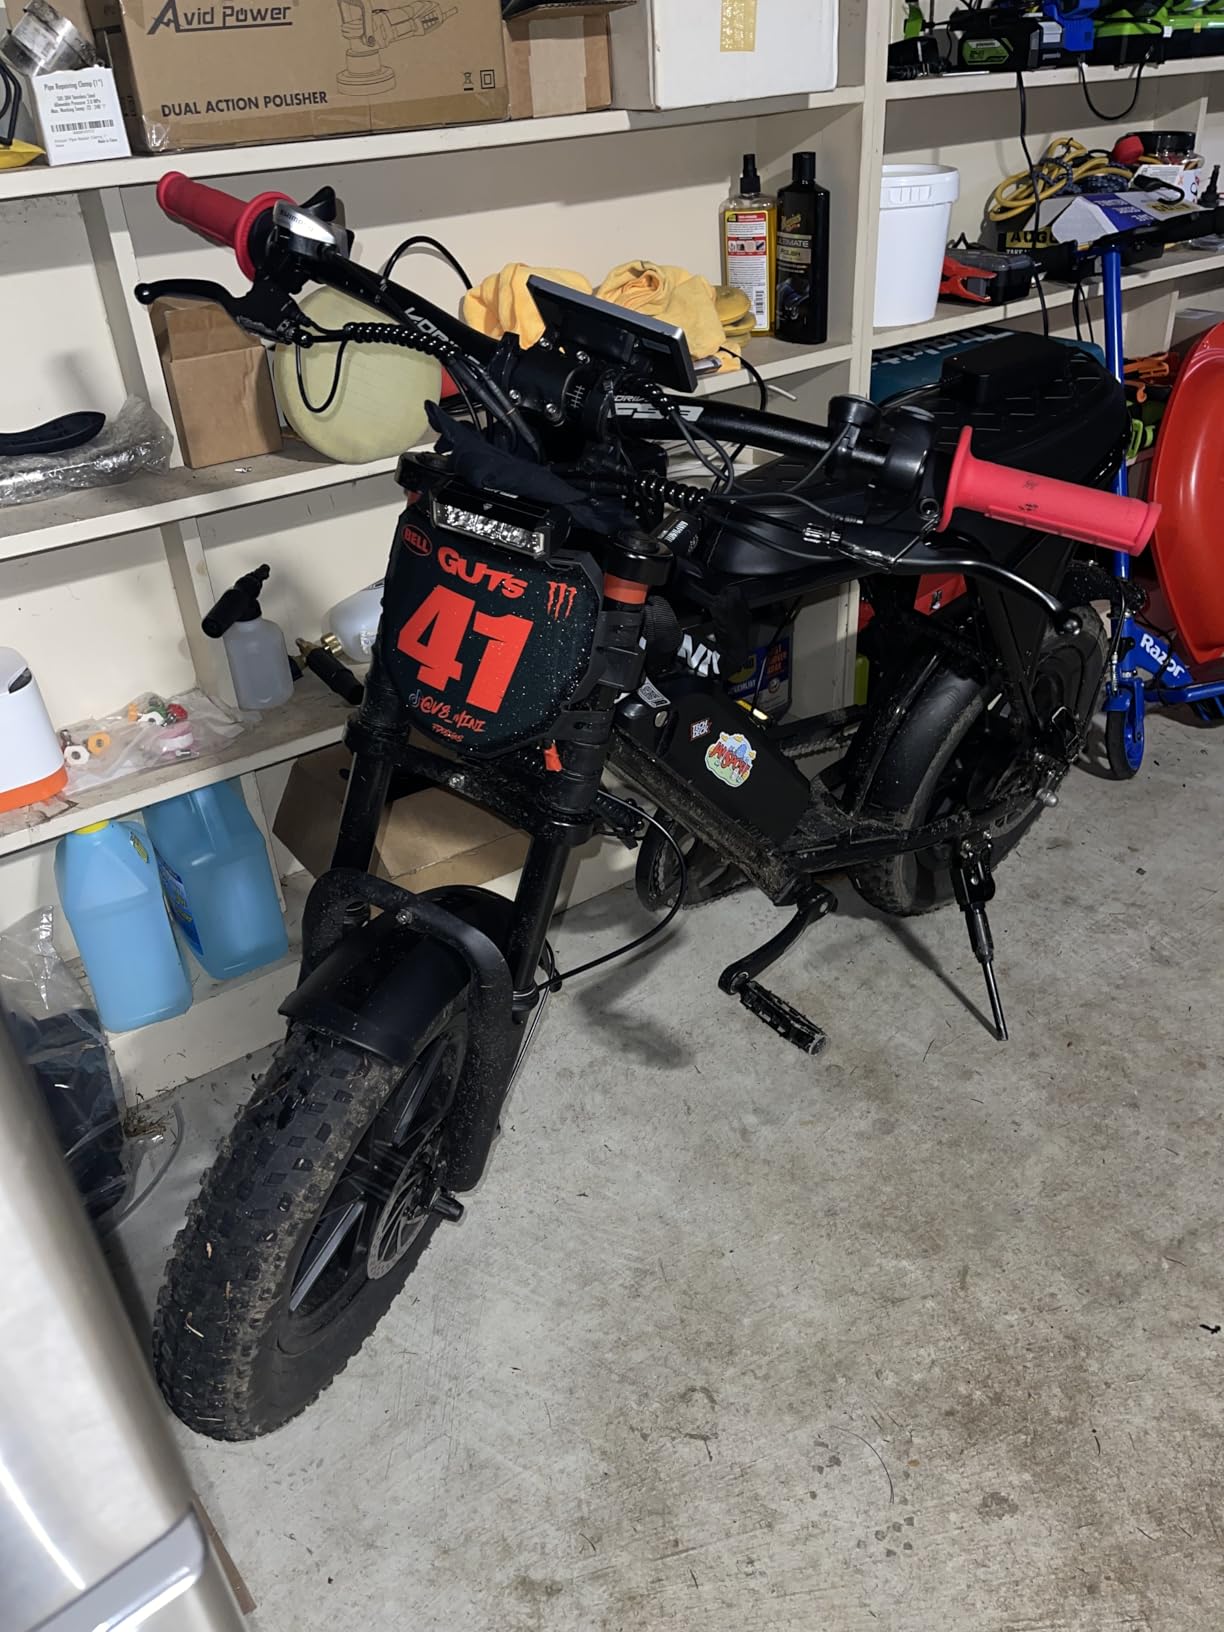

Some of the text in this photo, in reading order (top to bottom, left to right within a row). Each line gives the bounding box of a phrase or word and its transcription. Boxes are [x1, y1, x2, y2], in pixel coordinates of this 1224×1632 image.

[147, 0, 292, 35] Avid Power
[43, 83, 54, 91] Pipe
[161, 91, 328, 118] DUAL ACTION POLISHER
[404, 528, 429, 553] BELL
[437, 547, 528, 599] GUTS
[396, 584, 535, 714] 41
[1140, 633, 1186, 678] Razor
